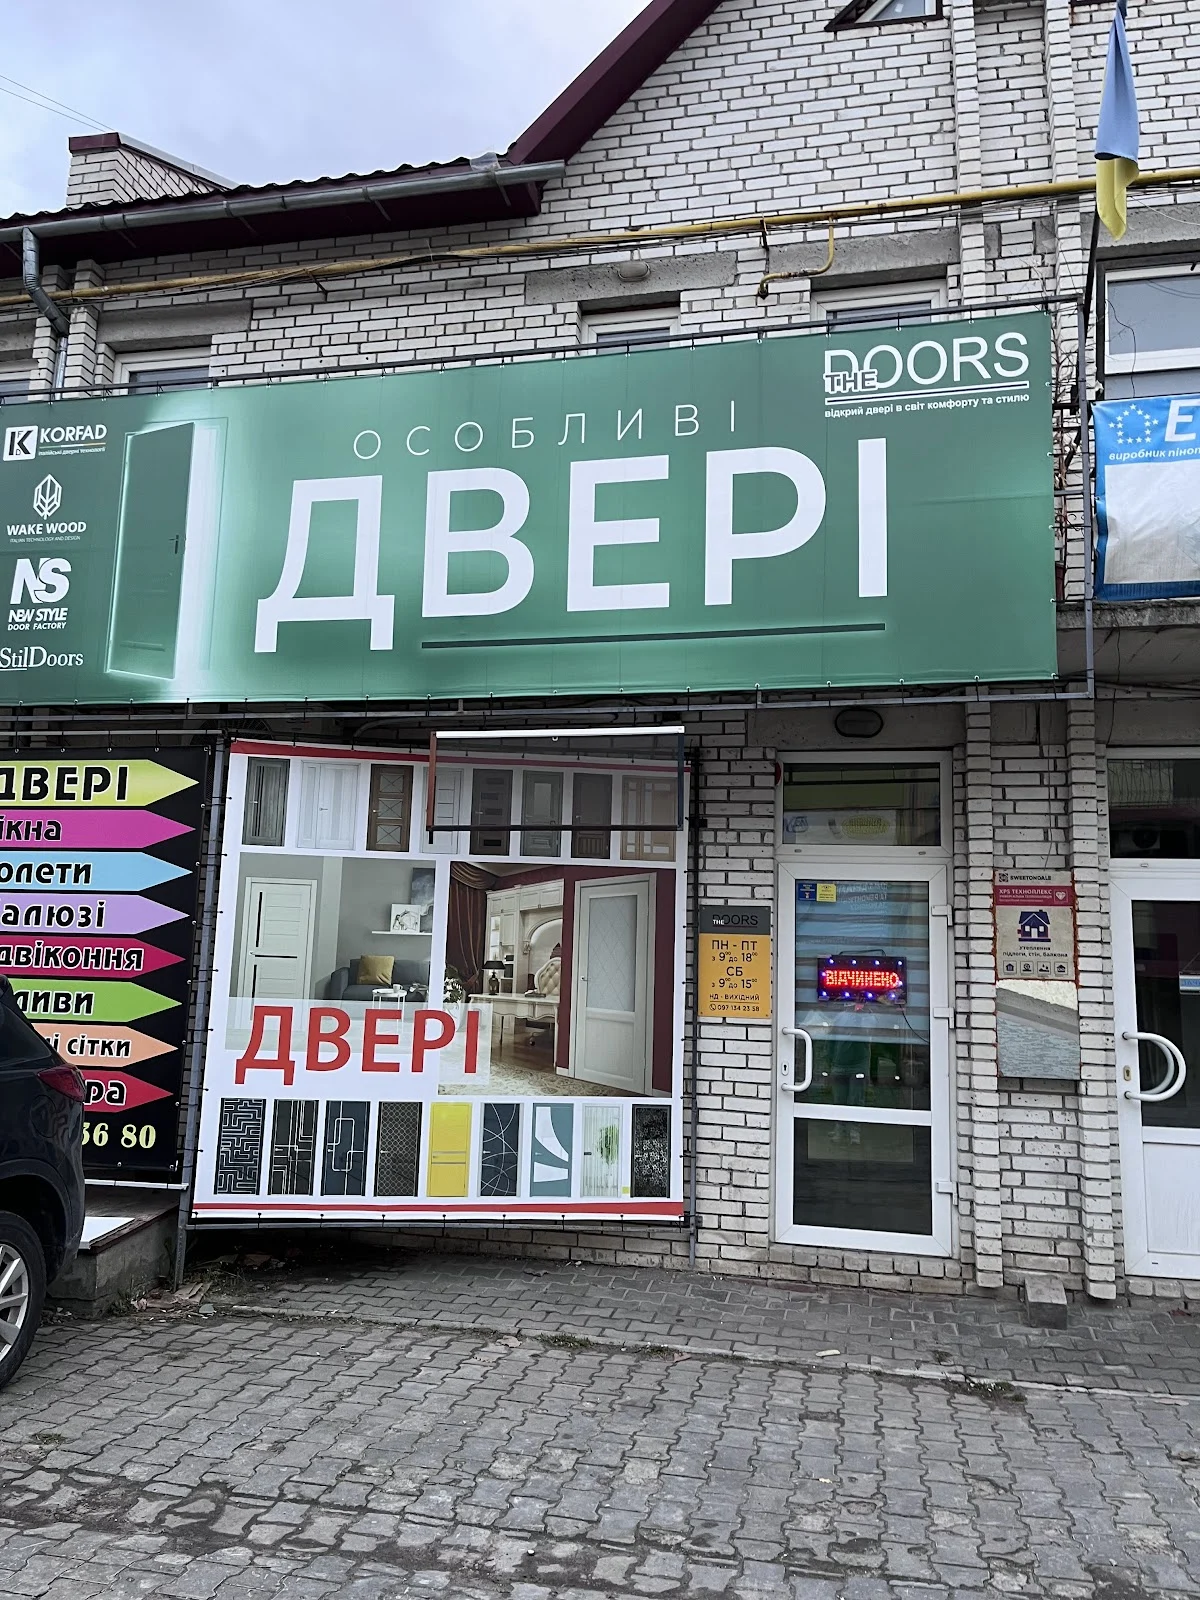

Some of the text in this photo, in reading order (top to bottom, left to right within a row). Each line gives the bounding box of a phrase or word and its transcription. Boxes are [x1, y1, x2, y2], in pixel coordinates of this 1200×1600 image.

[823, 331, 1030, 395] THE DOORS
[825, 406, 864, 419] відкрий
[866, 404, 894, 416] двері
[905, 401, 926, 412] світ
[927, 397, 980, 413] комфорту
[982, 397, 994, 406] та
[996, 394, 1030, 405] стилю
[40, 424, 107, 443] KORFAD
[353, 400, 738, 460] ОСОБЛИВІ
[1108, 448, 1166, 461] виробник
[7, 521, 87, 536] WAKE WOOD
[254, 437, 889, 653] ДВЕРІ
[10, 557, 72, 605] NS
[8, 607, 68, 623] NEW STYLE
[7, 622, 67, 631] DOOR FACTORY
[0, 646, 84, 668] StilDoors
[0, 863, 92, 884] олети
[712, 914, 758, 926] DOORS
[712, 940, 729, 950] ПН
[742, 941, 757, 951] ПТ
[726, 966, 743, 977] СБ
[826, 970, 899, 987] ВІДЧИНЕНО
[67, 1034, 131, 1058] сітки
[235, 1006, 480, 1086] ДВЕРІ
[120, 1124, 157, 1149] 80
